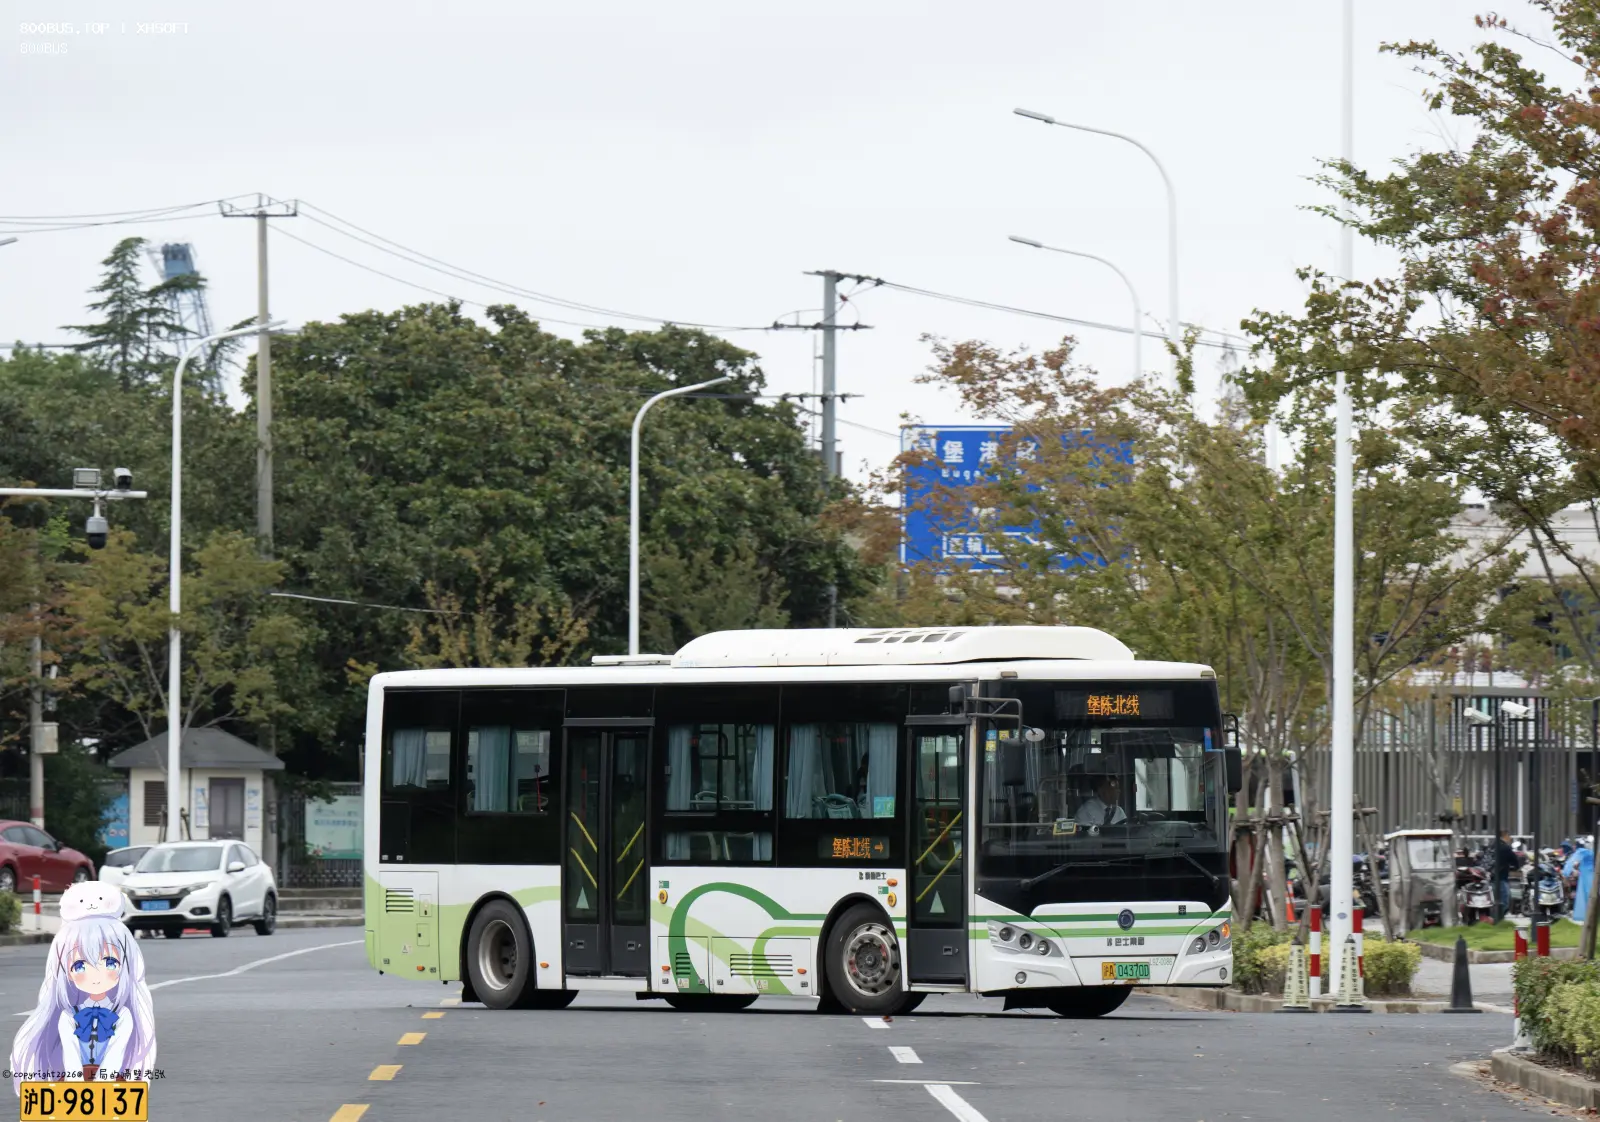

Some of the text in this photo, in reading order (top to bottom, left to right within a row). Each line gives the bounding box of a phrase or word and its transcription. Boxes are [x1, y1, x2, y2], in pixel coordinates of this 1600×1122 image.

[1087, 694, 1140, 716] 堡陈北线
[832, 837, 871, 859] 堡陈北线
